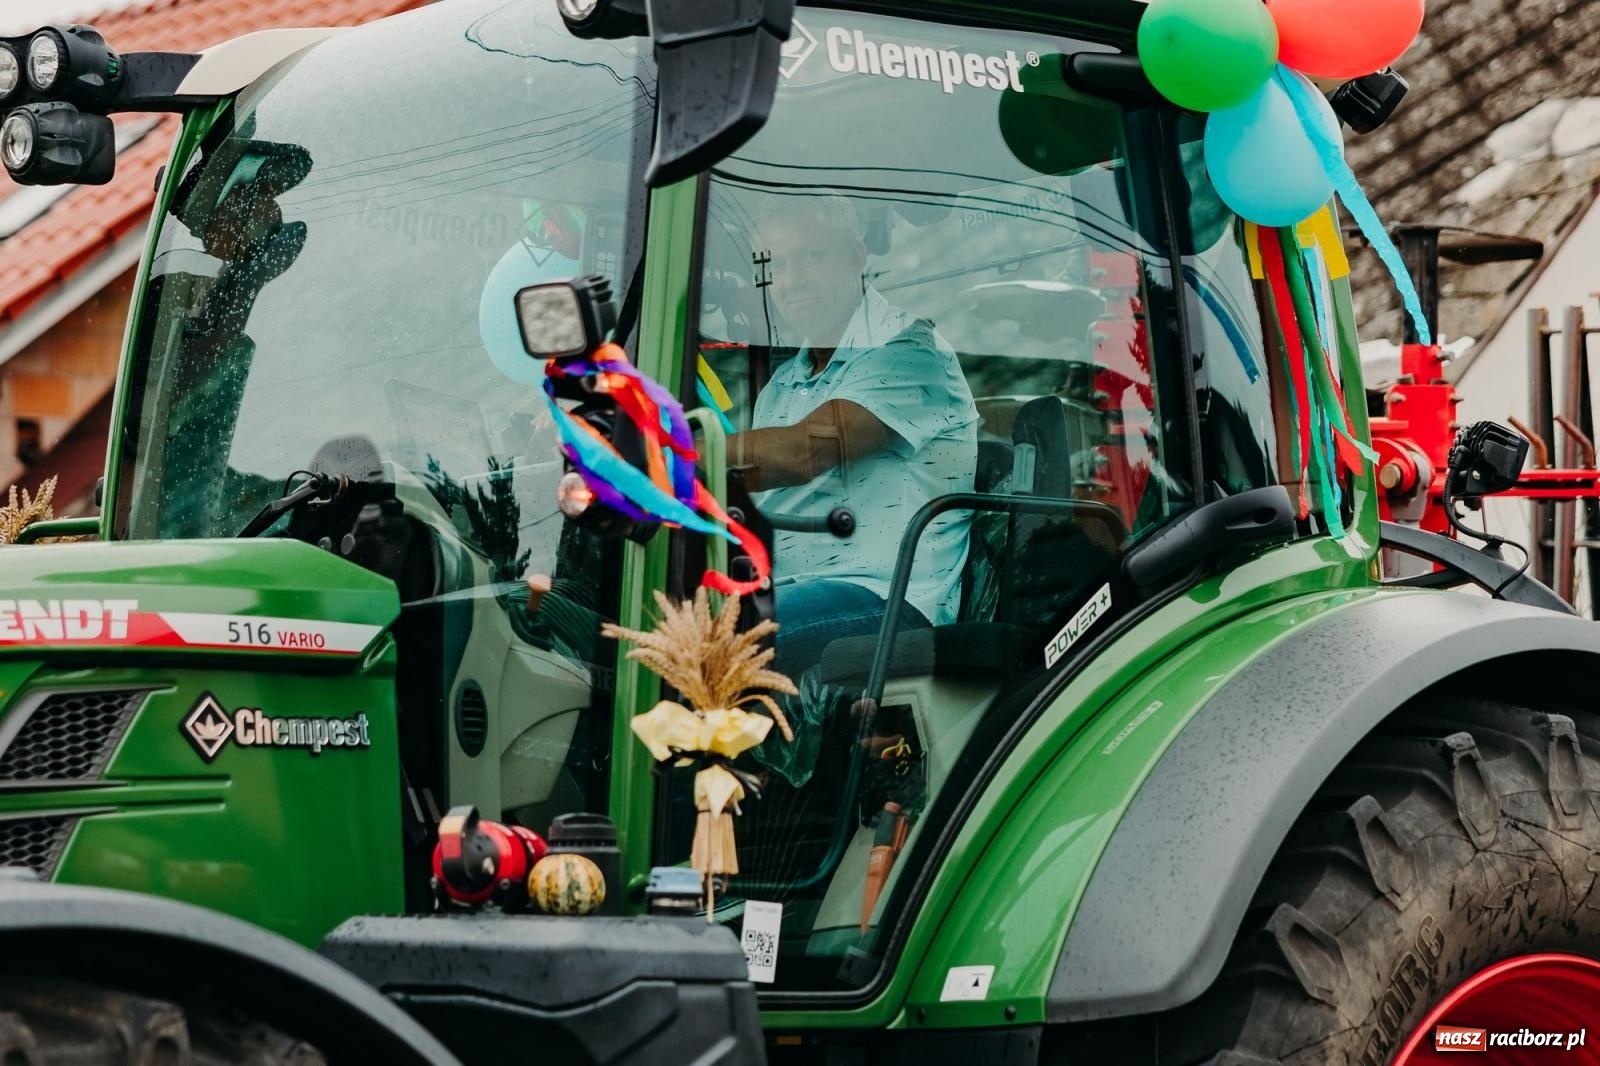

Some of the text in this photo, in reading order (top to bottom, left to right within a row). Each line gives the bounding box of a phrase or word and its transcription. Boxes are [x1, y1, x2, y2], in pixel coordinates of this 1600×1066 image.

[228, 621, 326, 648] 516 VARIO
[234, 708, 371, 753] Chempest
